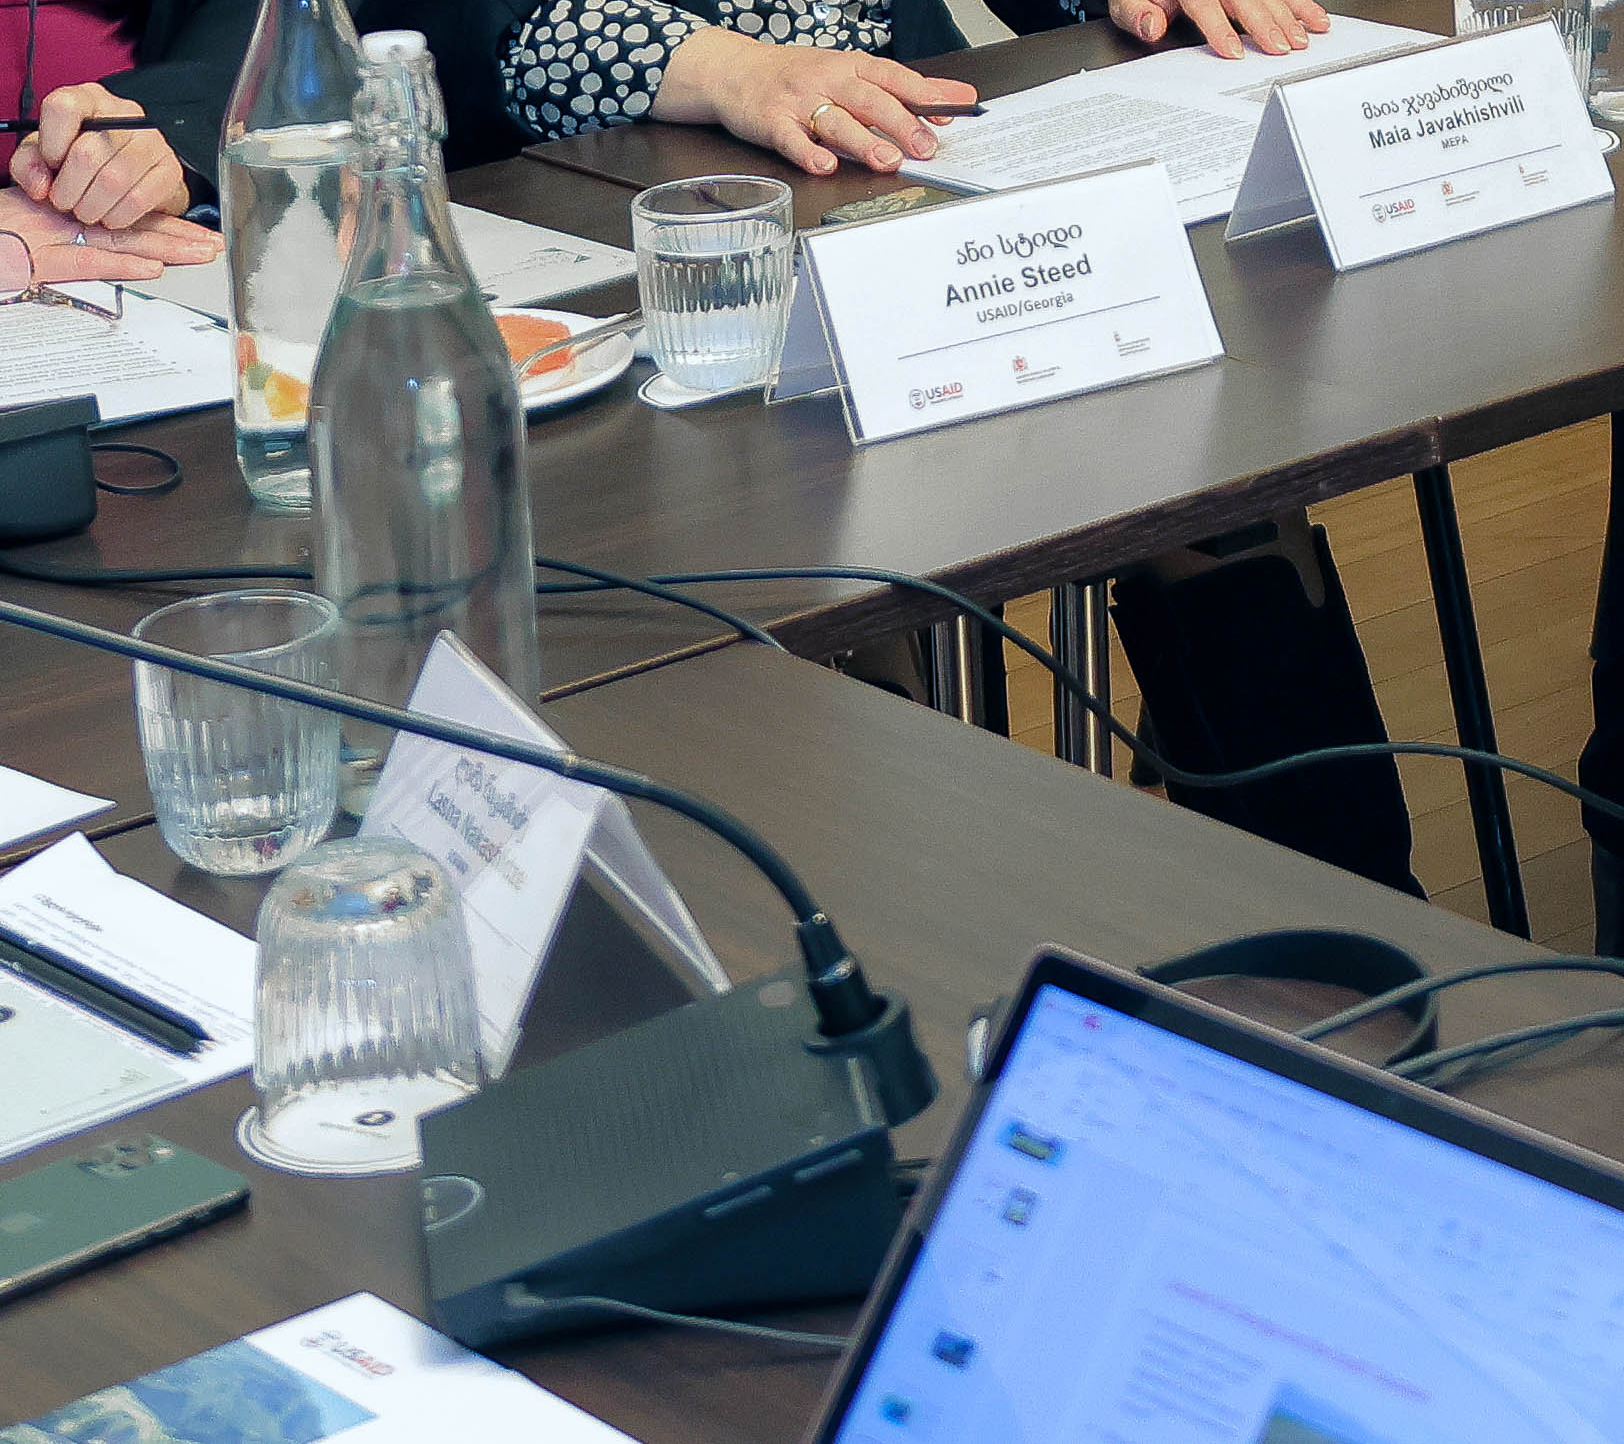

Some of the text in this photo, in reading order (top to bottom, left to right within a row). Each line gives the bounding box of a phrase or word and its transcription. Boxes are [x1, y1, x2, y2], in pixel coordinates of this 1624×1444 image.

[1361, 72, 1513, 119] მაია ჯავახიშვილი
[1369, 95, 1525, 149] Maia Javakhishvili
[1441, 135, 1469, 149] MEPA
[1386, 199, 1415, 214] USAID
[956, 224, 1082, 265] ანი სტიდი
[946, 253, 1092, 307] Annie Steed
[976, 291, 1074, 323] USAID/Georgia
[925, 382, 963, 400] USAID
